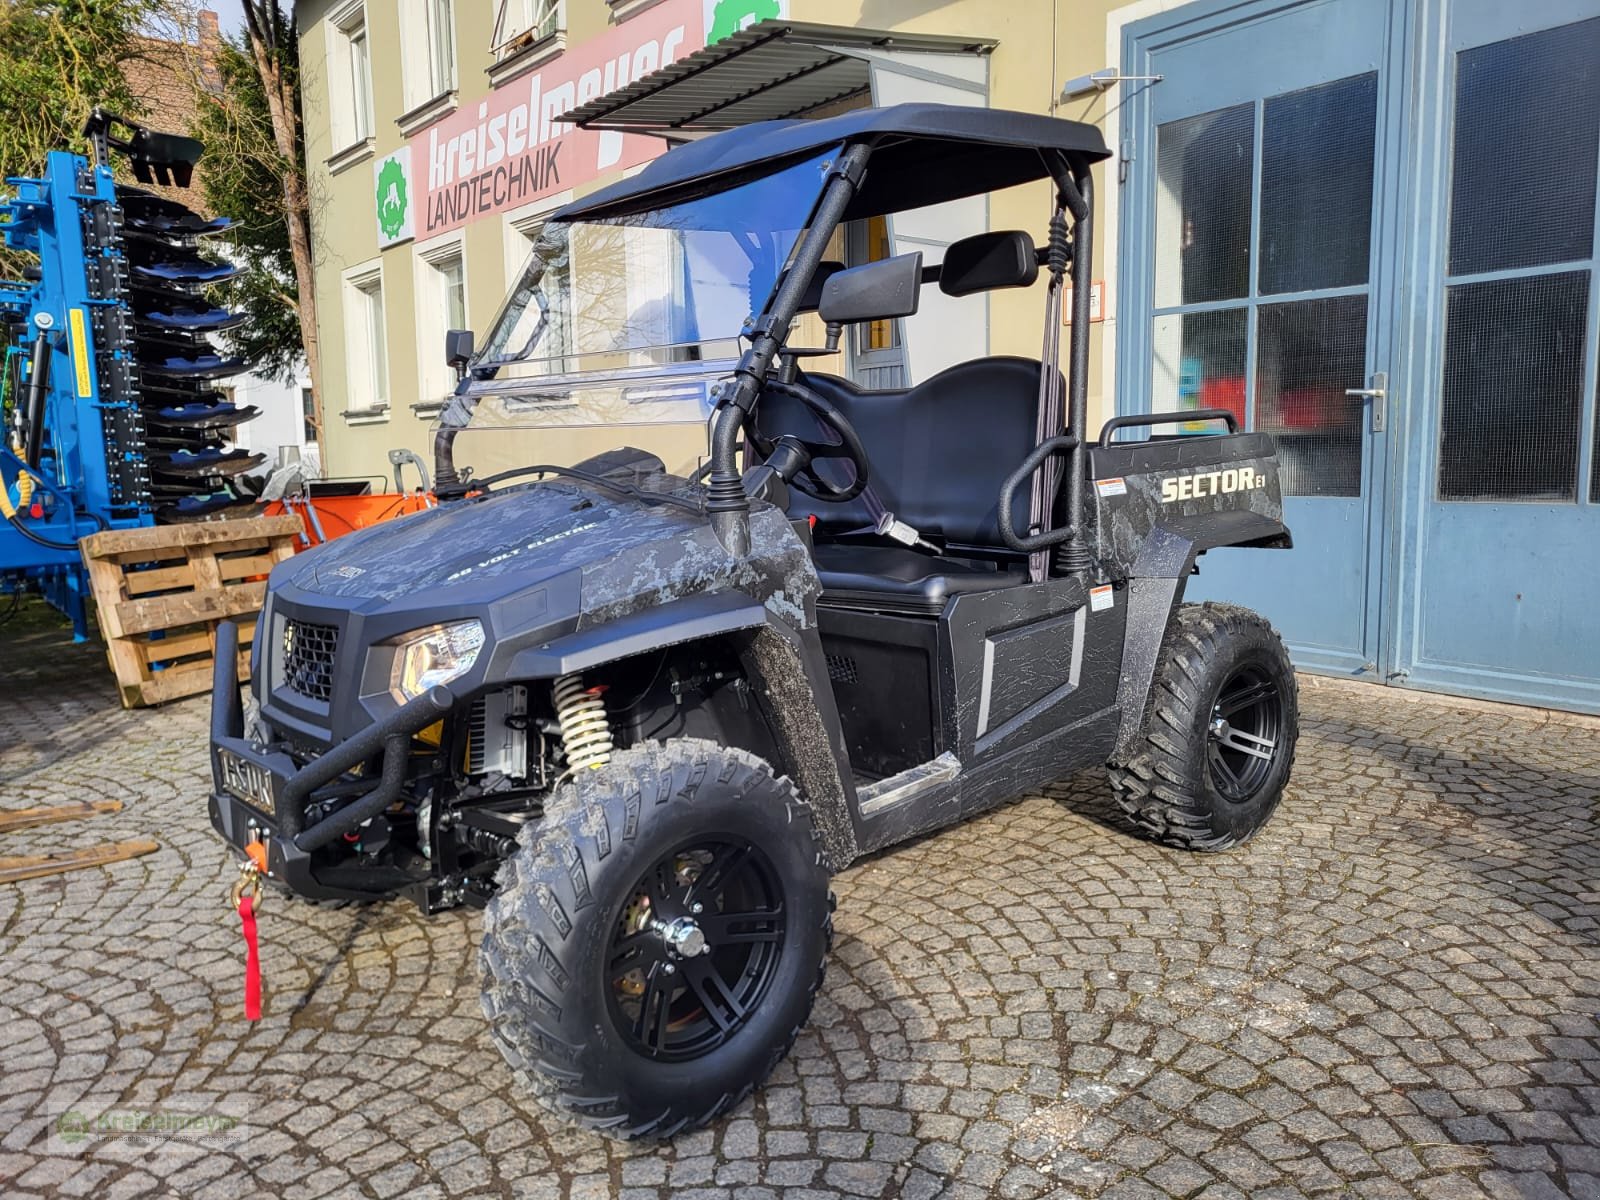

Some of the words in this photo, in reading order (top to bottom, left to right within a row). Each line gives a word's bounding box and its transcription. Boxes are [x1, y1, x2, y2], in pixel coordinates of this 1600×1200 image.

[427, 141, 562, 231] LANDTECHNIK
[1162, 467, 1255, 503] SECTOR
[1256, 474, 1266, 489] E1
[478, 549, 520, 567] VOLT
[527, 522, 598, 549] ELECTRIC
